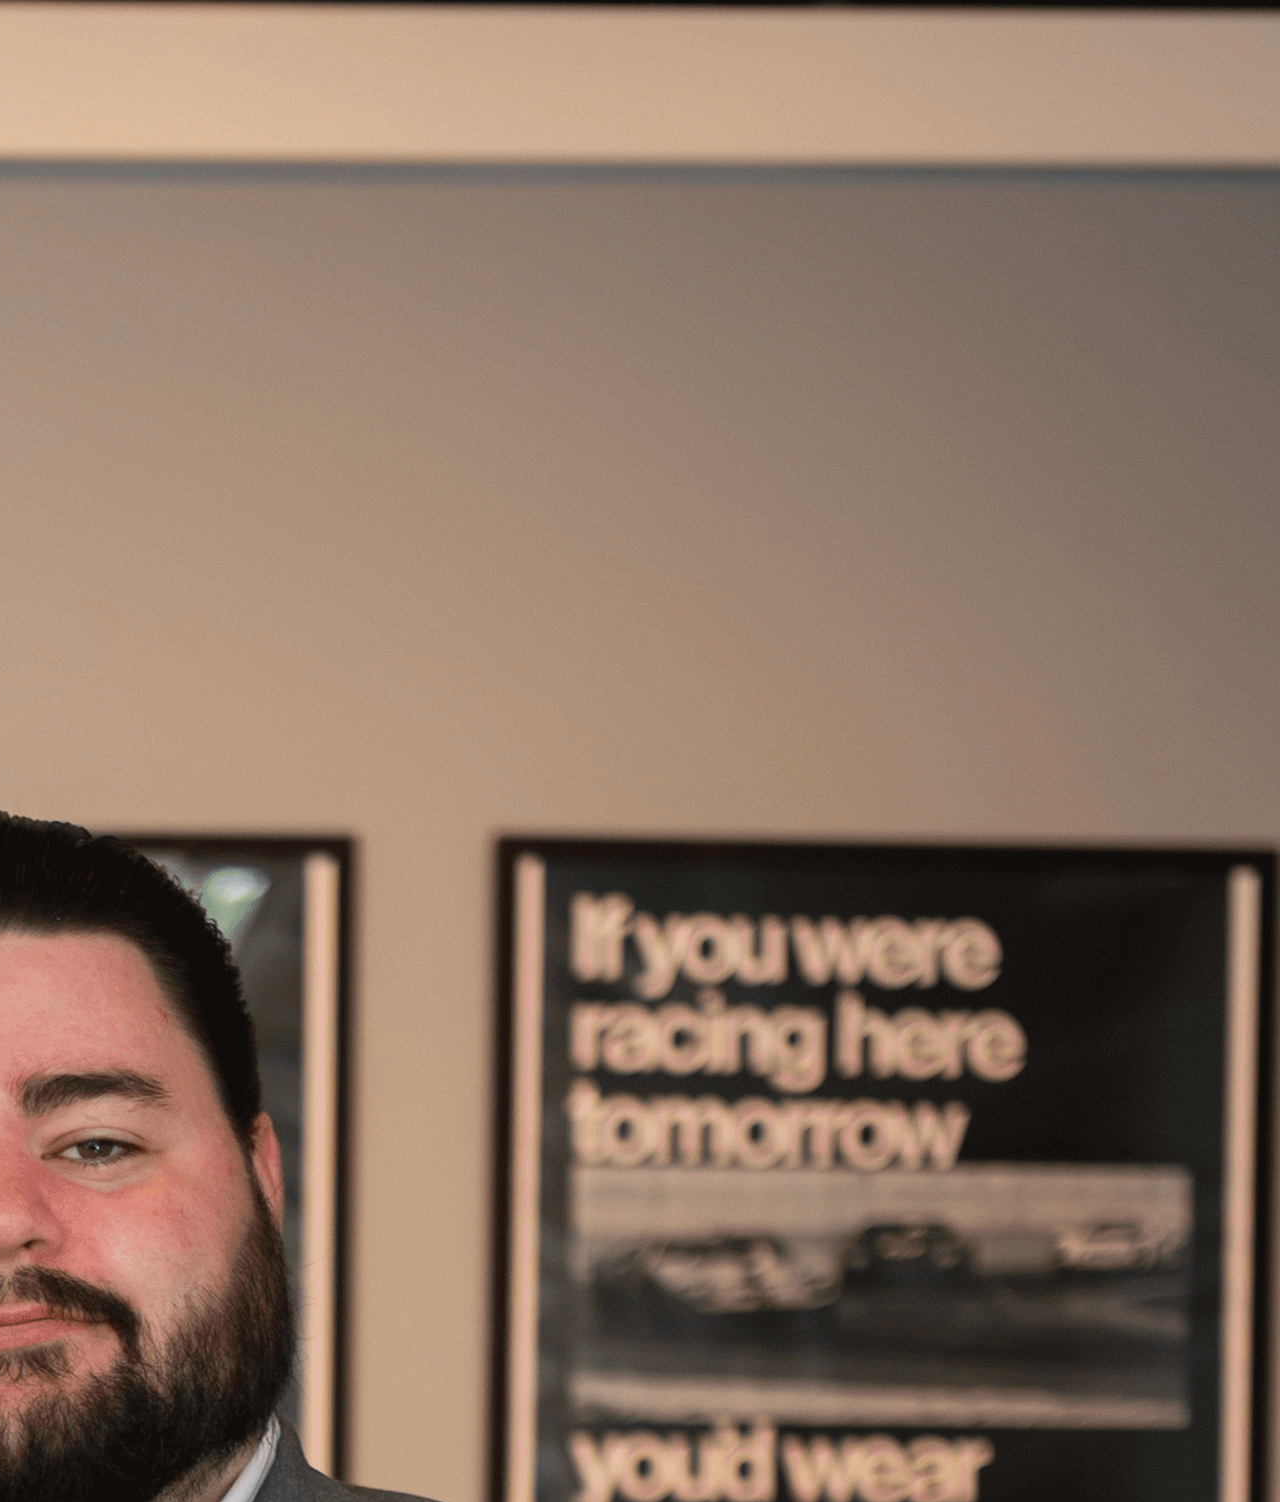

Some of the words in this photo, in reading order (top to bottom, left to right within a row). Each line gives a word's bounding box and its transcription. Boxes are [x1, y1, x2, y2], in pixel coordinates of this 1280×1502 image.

[570, 891, 634, 983] If
[634, 911, 789, 999] you
[790, 914, 1003, 991] were
[570, 987, 828, 1093] racing
[834, 987, 1027, 1082] here
[569, 1077, 972, 1170] tomorrow
